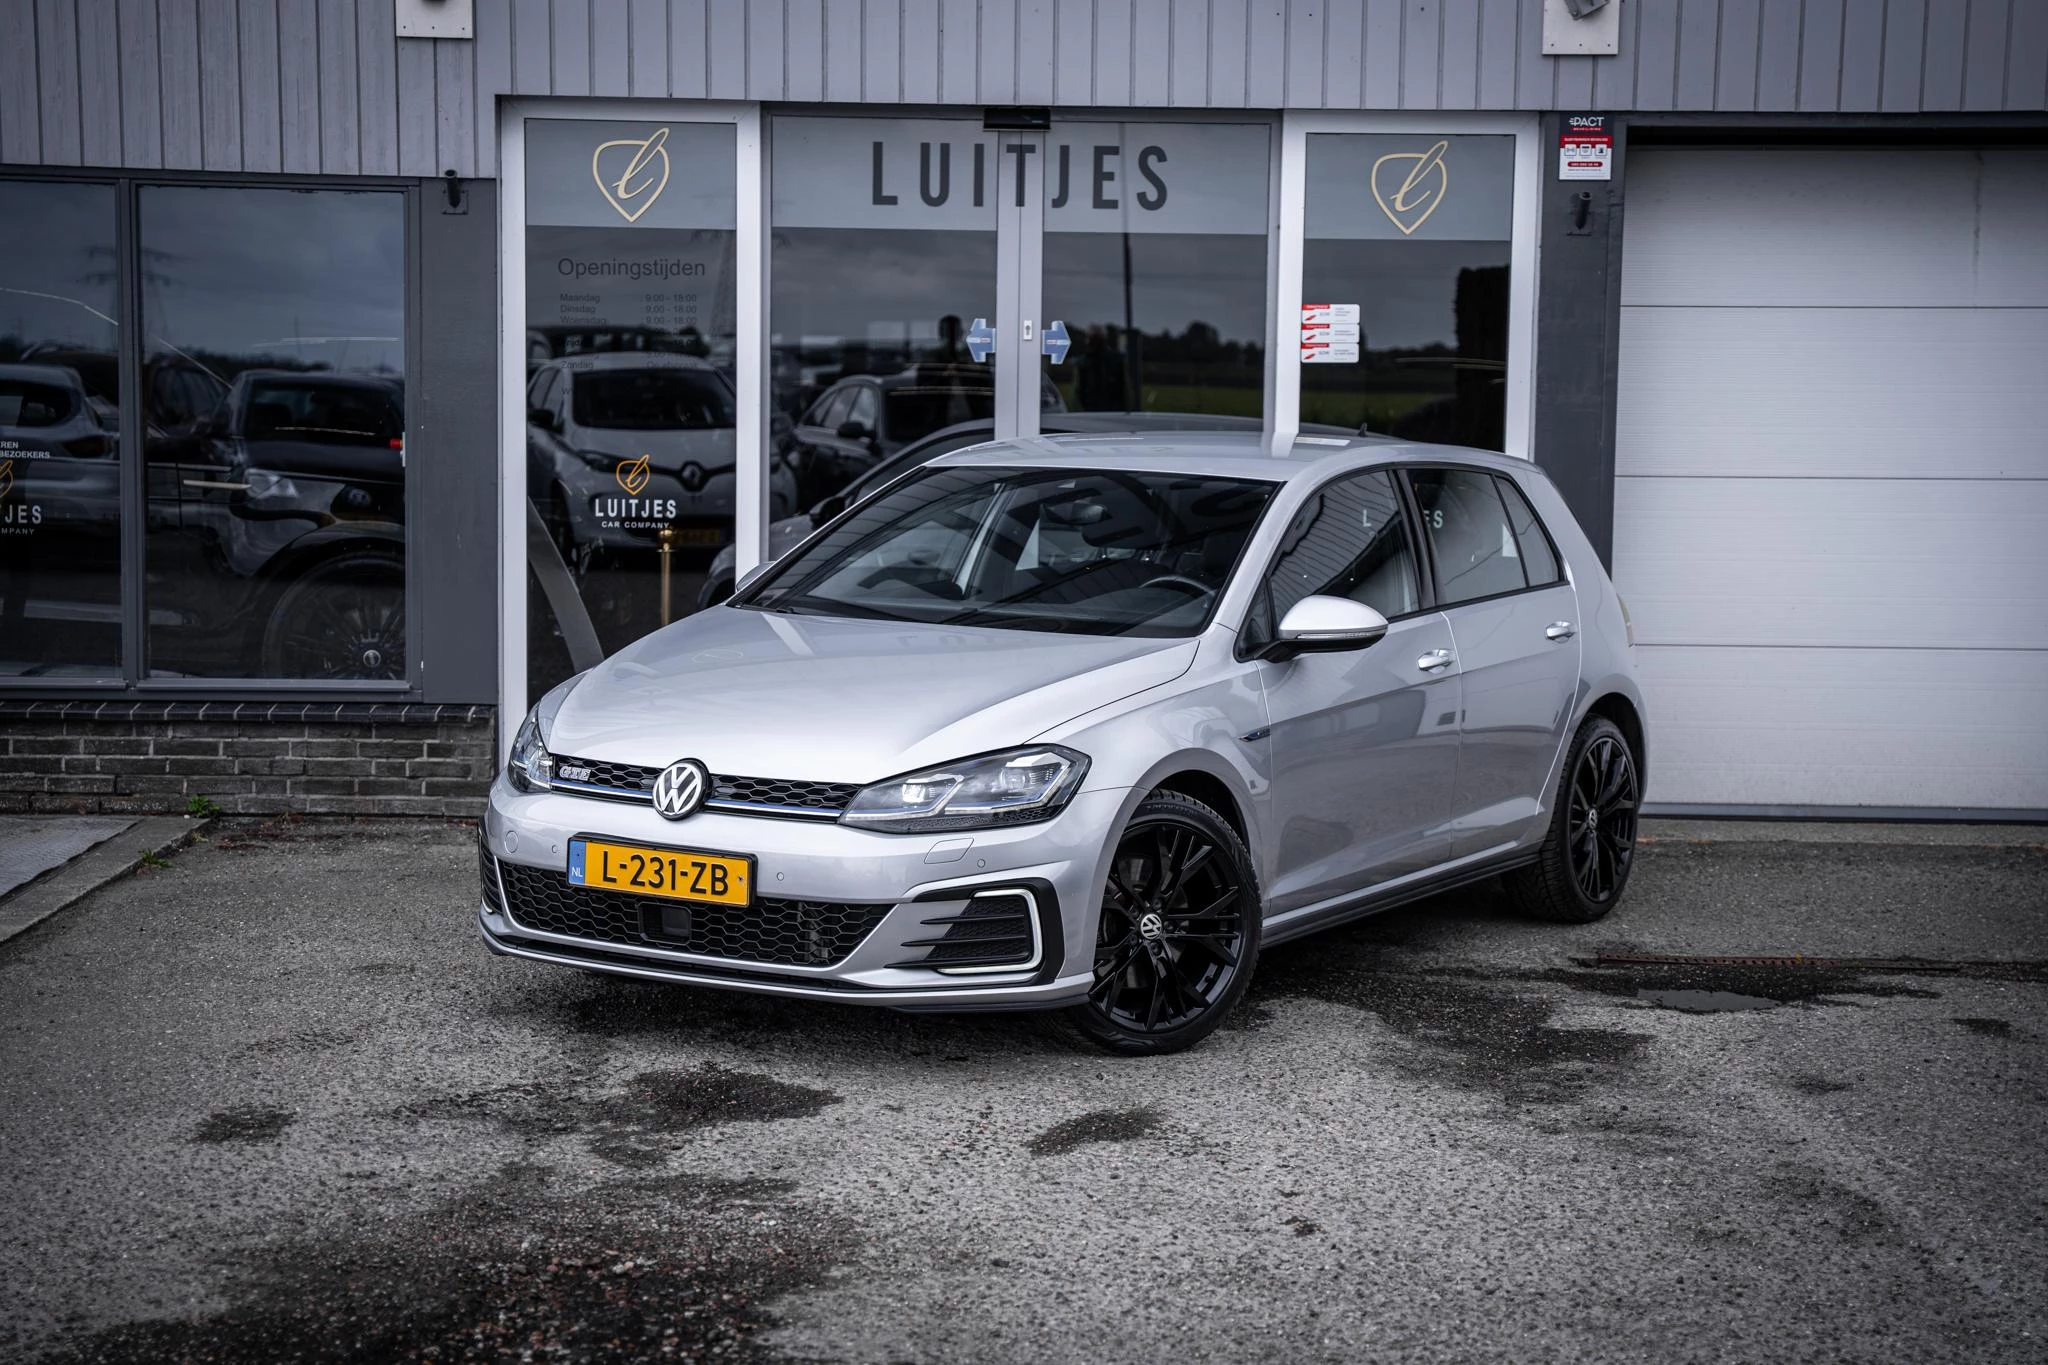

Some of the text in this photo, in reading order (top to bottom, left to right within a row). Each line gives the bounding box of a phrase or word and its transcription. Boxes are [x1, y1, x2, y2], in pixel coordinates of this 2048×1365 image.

[1571, 116, 1604, 126] PACT
[872, 141, 1168, 211] LUITJES
[558, 257, 705, 280] Openingstijden
[560, 293, 600, 304] Maandag
[560, 304, 596, 314] Dinsdag
[0, 504, 42, 524] JES
[595, 499, 677, 518] LUITJES
[624, 521, 670, 529] COMPANY
[559, 766, 592, 781] GTE
[571, 866, 583, 878] NL
[602, 851, 729, 896] L-231-ZB
